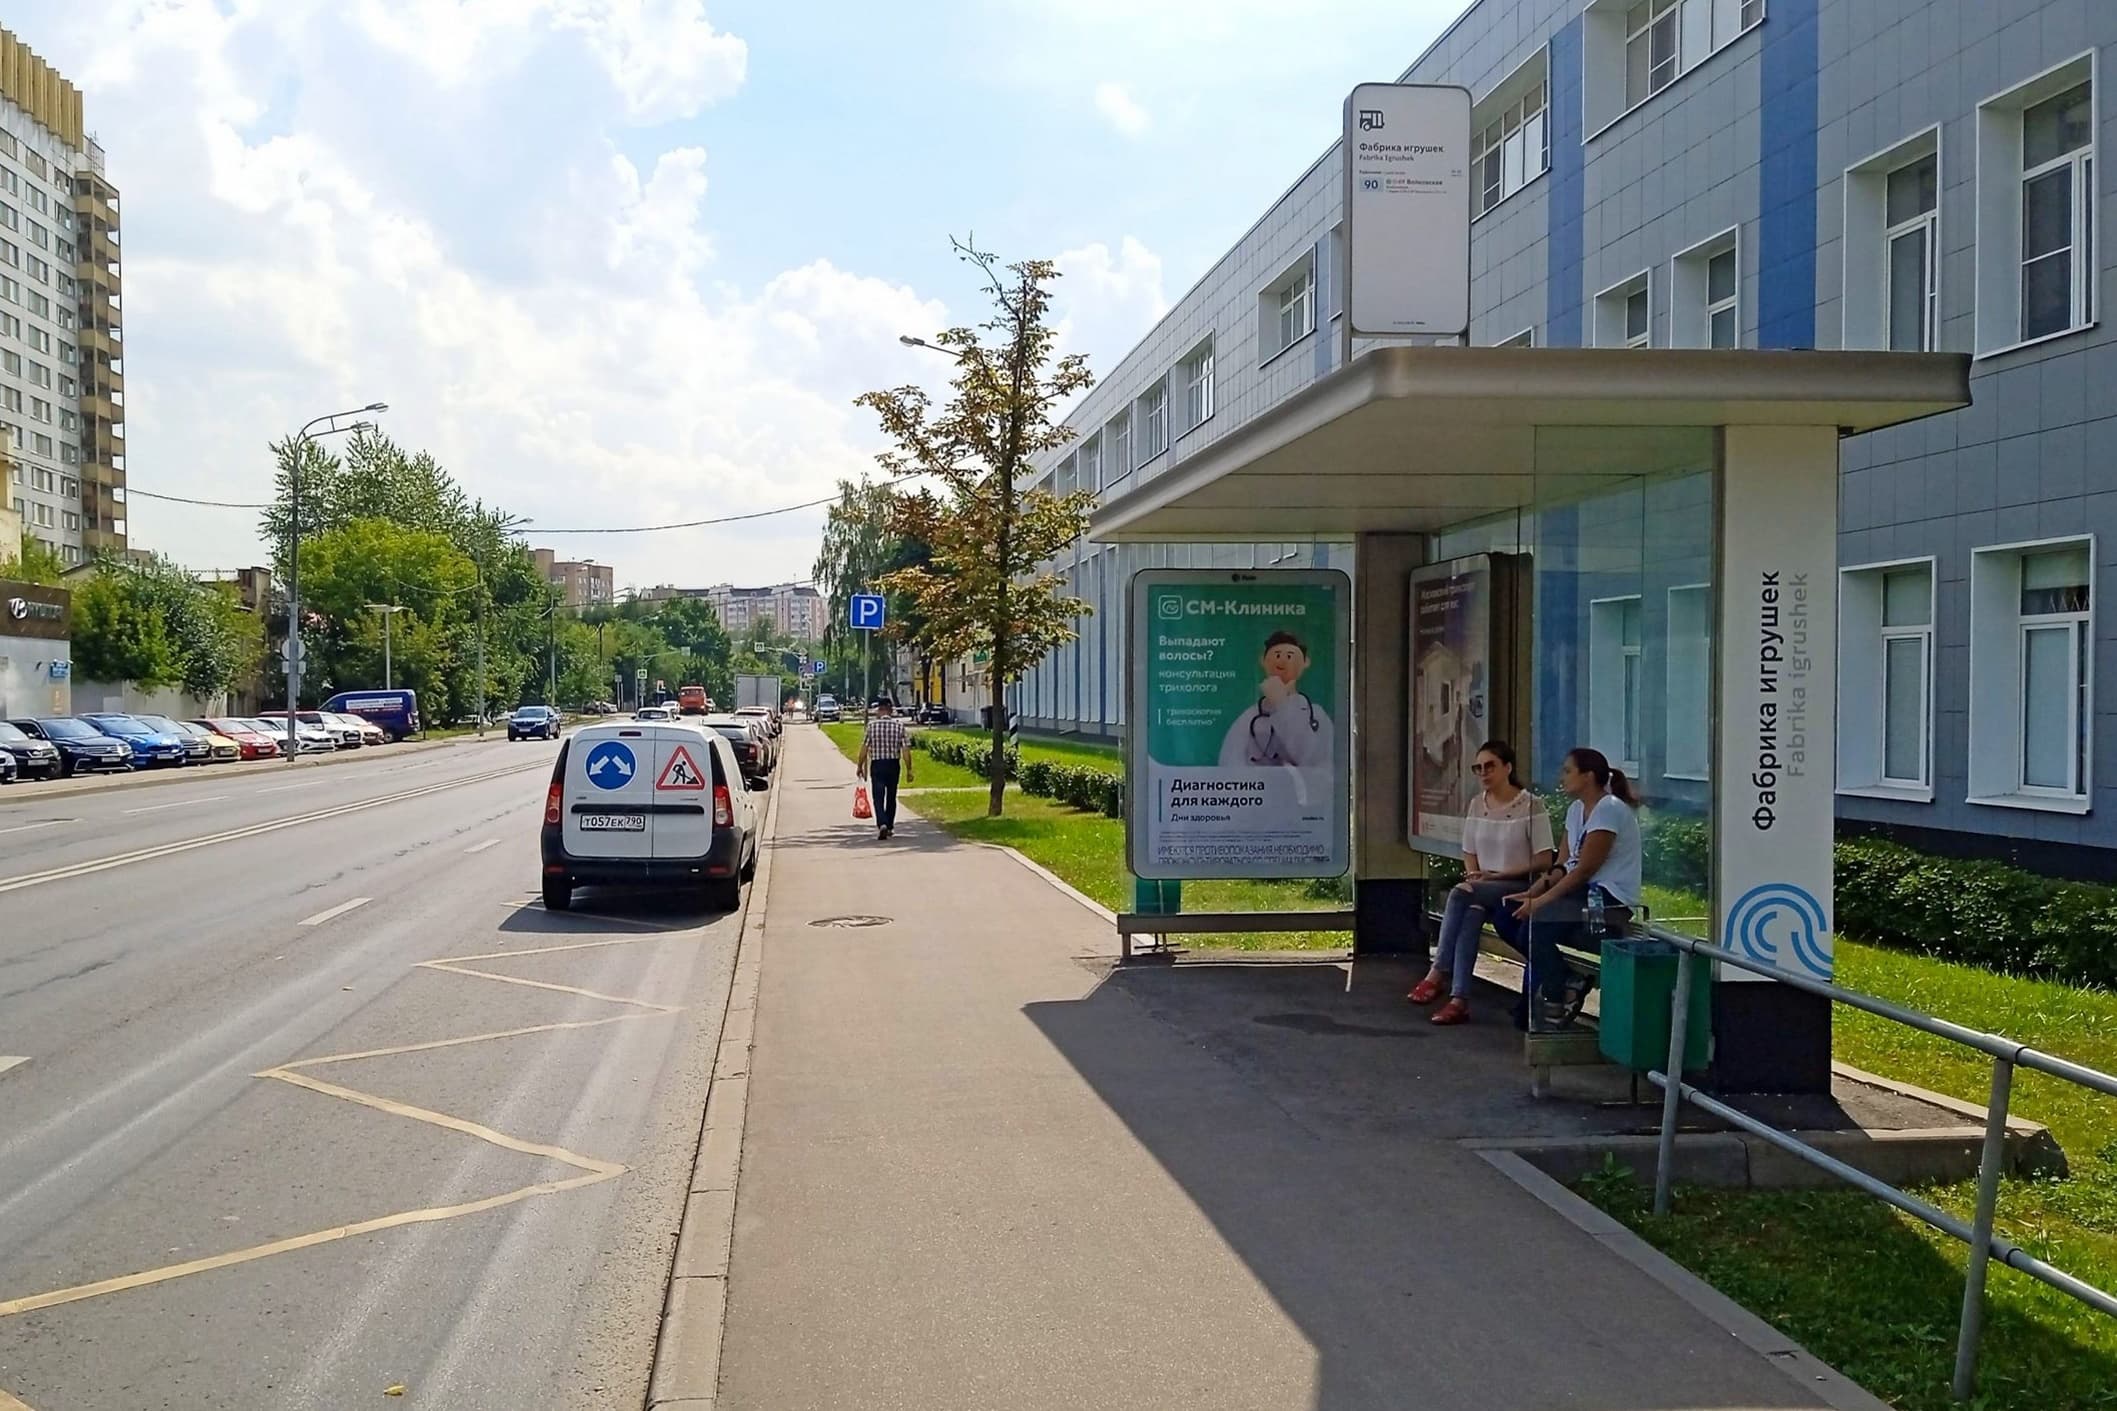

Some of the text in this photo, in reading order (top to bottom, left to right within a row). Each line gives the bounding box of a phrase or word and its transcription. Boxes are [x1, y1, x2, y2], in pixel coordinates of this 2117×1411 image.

[1359, 142, 1444, 154] Фабрика игрушек
[1364, 180, 1379, 189] 90
[860, 599, 878, 625] P
[1186, 600, 1306, 616] СМ-Клиника
[1159, 635, 1225, 648] Выпадают
[1159, 650, 1214, 661] волосы?
[1159, 670, 1236, 680] консультация
[1787, 572, 1811, 777] Fabrika igrushek
[1159, 683, 1218, 693] трихолога
[1752, 570, 1784, 831] Фабрика игрушек
[1171, 778, 1265, 793] Диагностика
[1171, 796, 1264, 808] для каждого
[626, 816, 643, 825] 790
[1171, 814, 1231, 824] Дни здоровья
